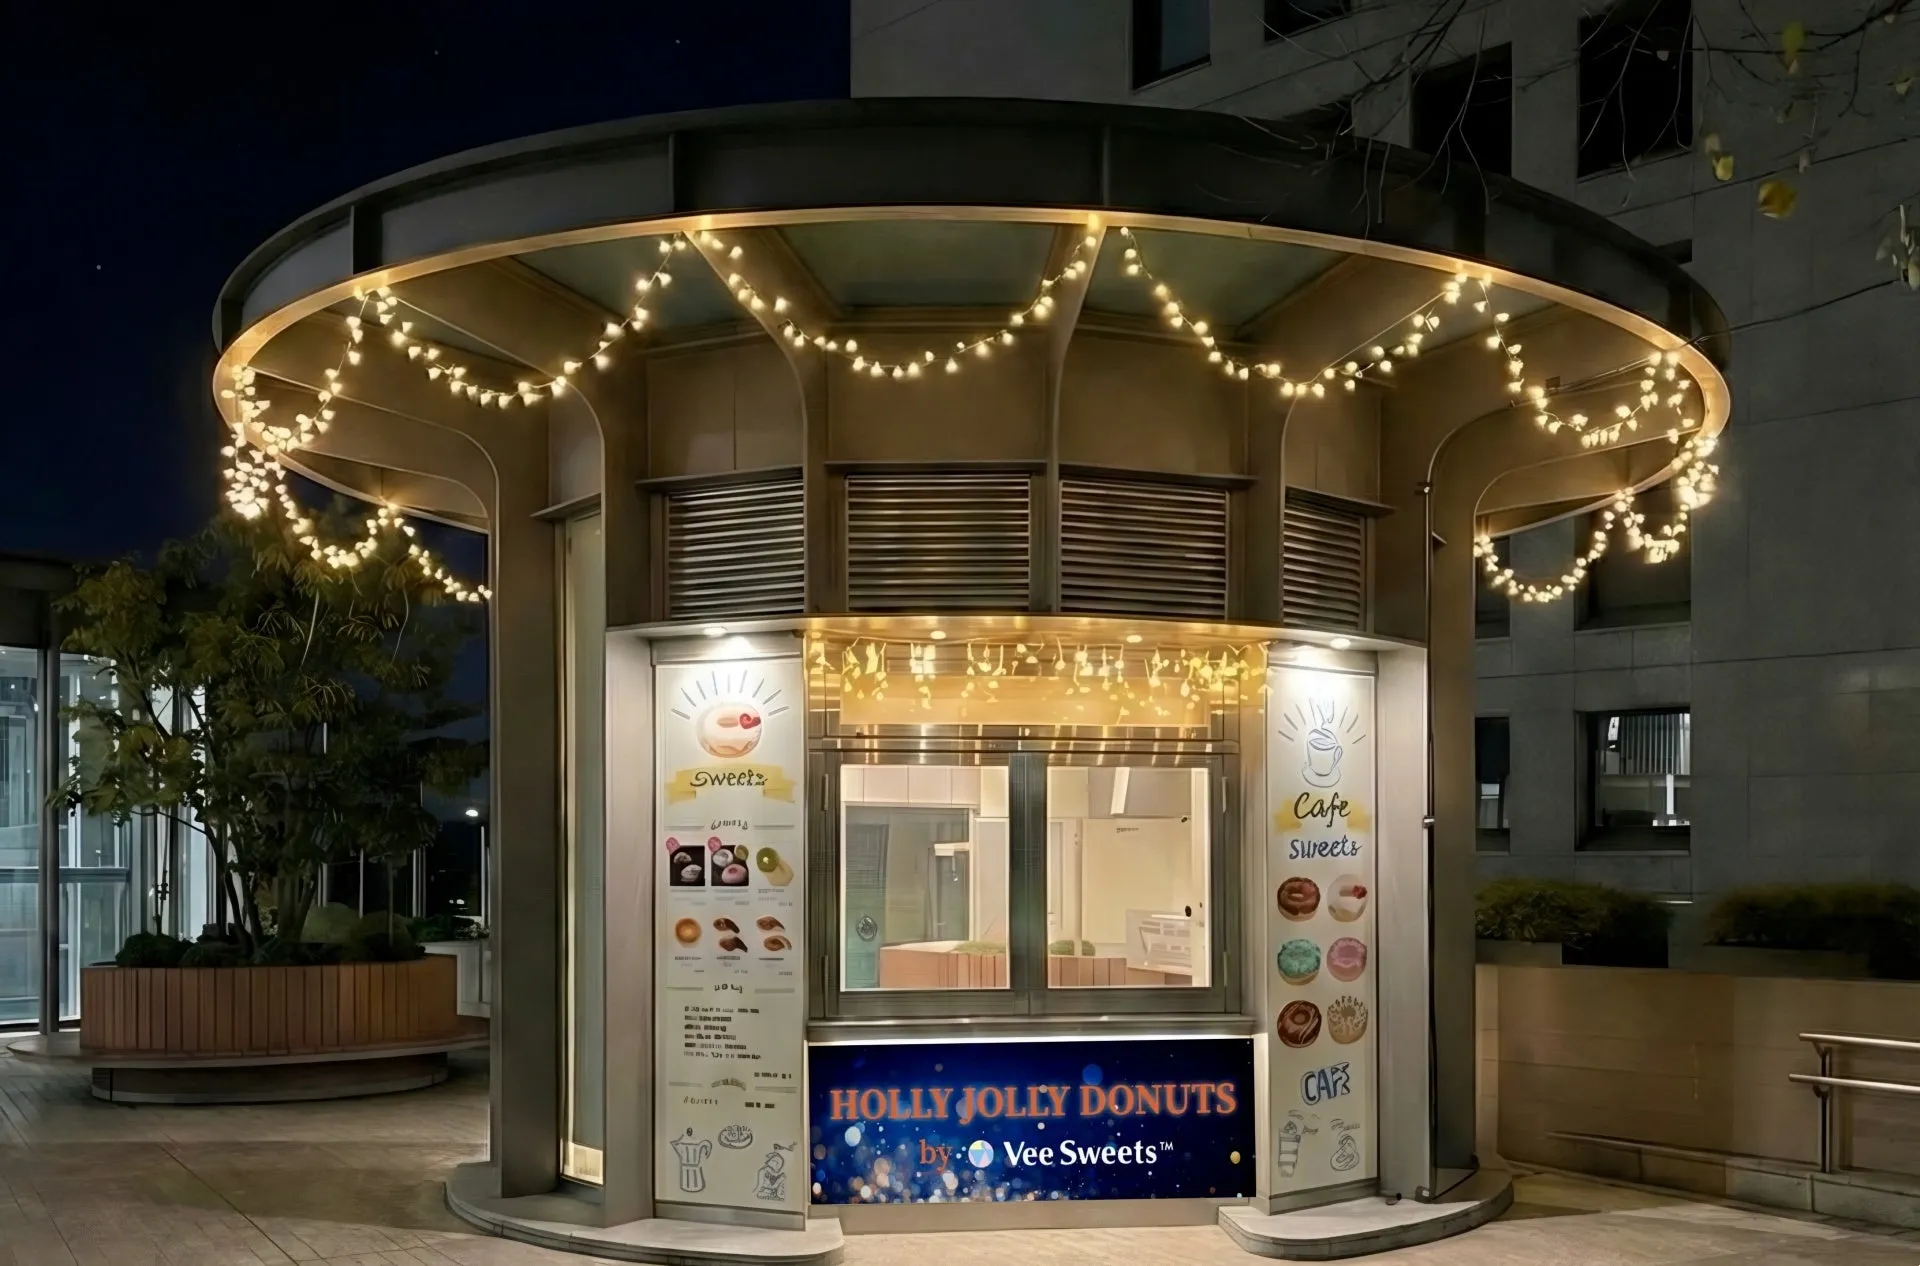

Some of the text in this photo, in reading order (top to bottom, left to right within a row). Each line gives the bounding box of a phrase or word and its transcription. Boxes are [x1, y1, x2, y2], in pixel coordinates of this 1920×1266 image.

[830, 1082, 1237, 1125] HOLLY JOLLY DONUTS
[919, 1139, 951, 1172] by
